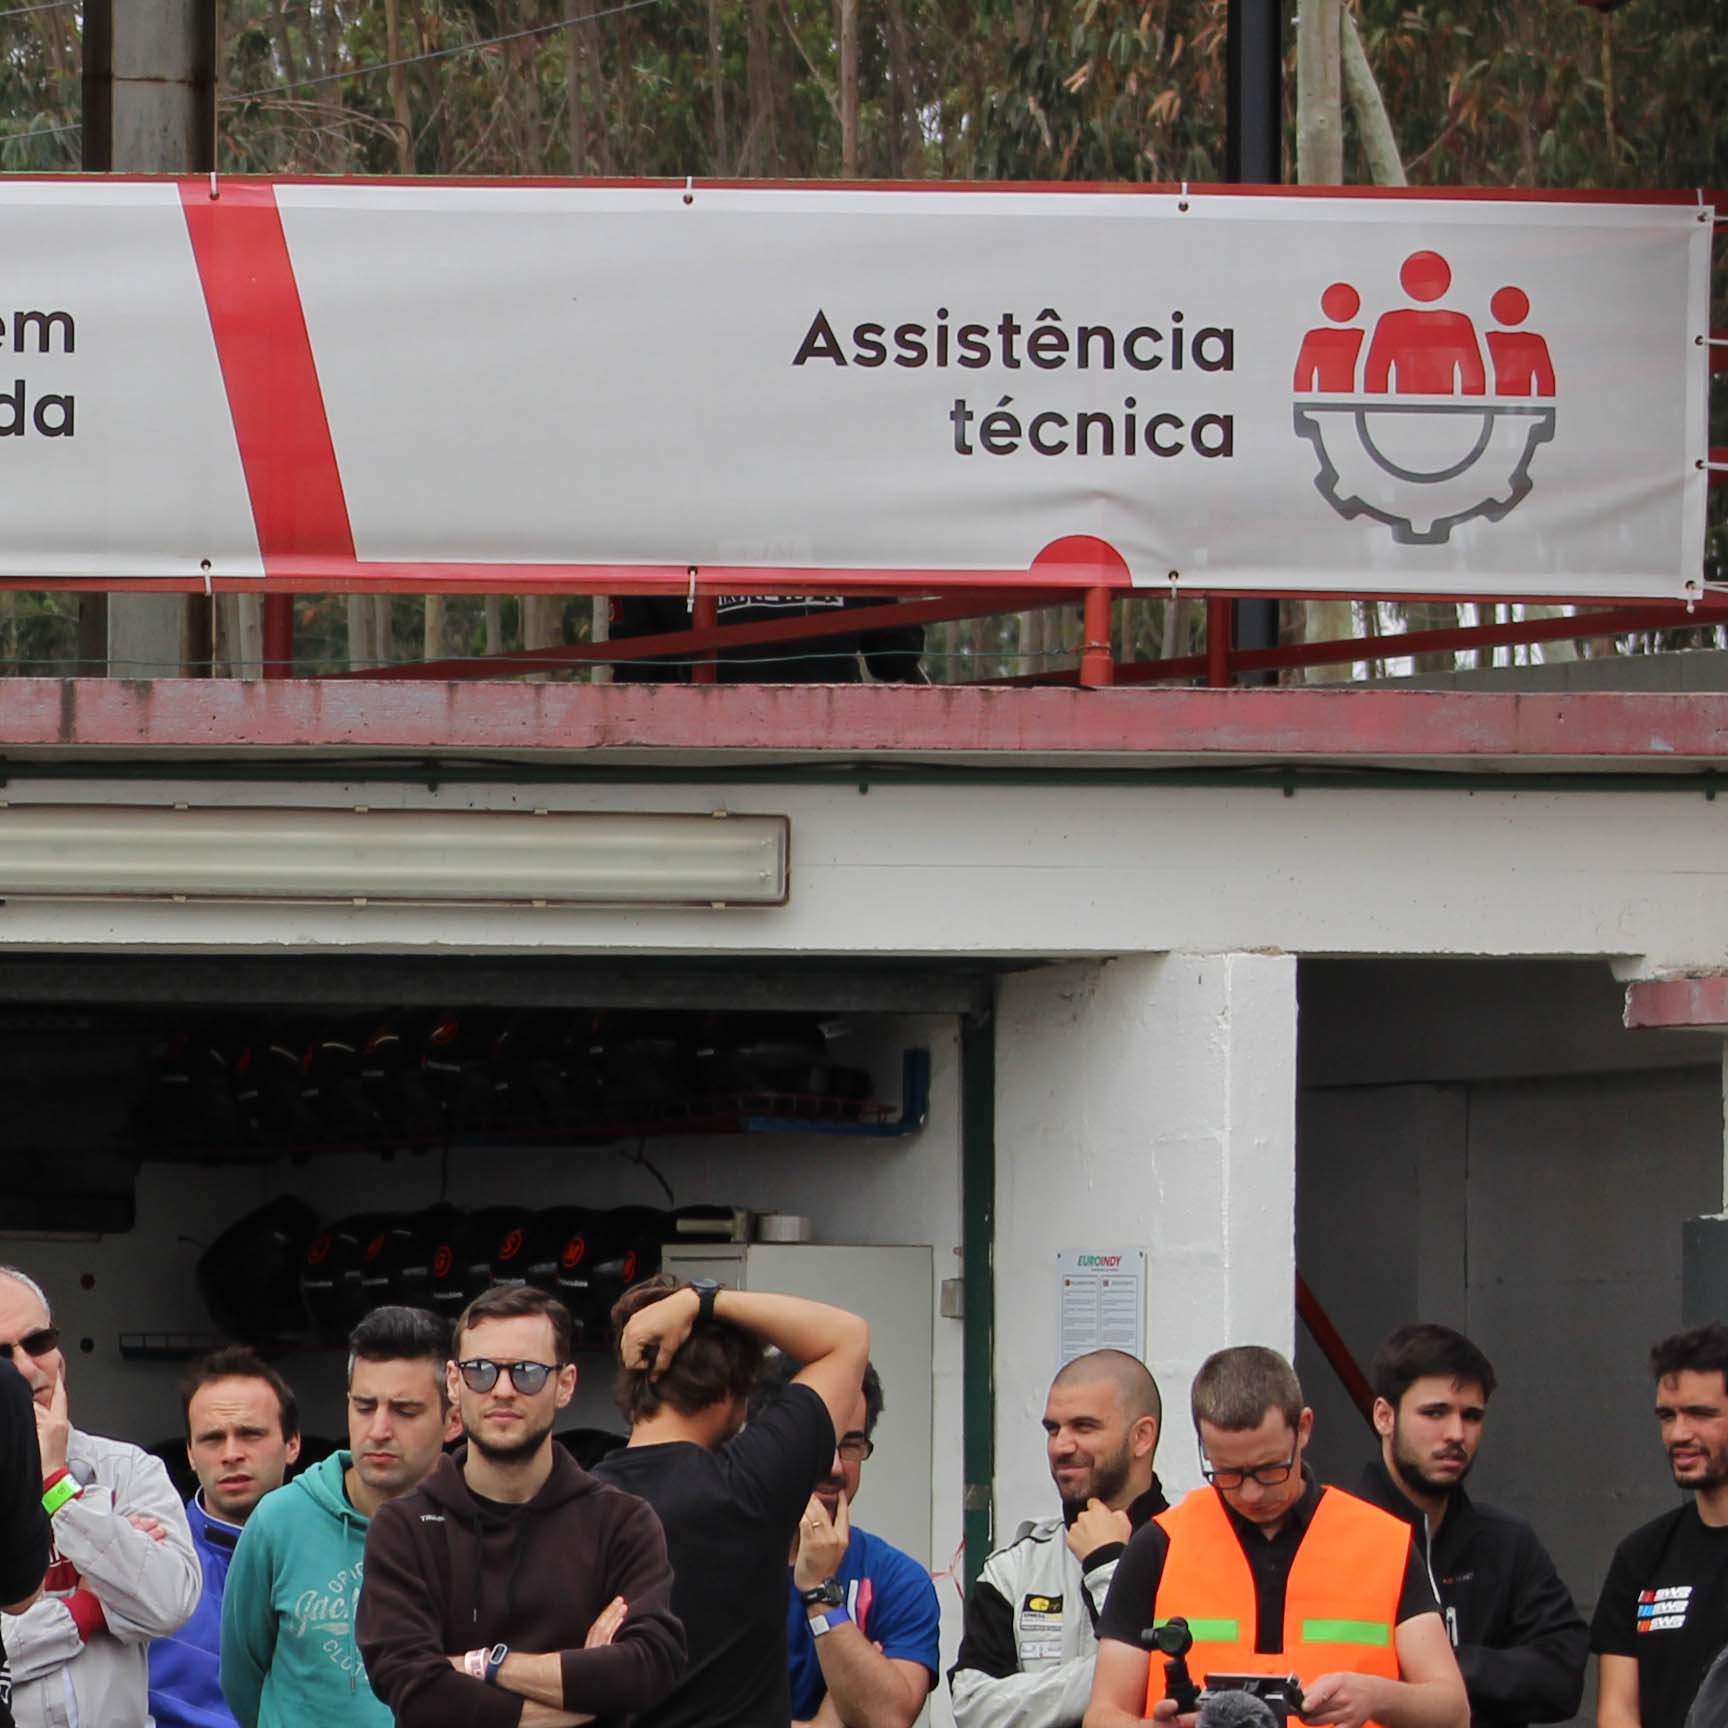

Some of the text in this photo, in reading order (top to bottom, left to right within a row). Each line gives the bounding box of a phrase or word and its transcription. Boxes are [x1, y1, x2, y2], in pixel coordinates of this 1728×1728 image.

[792, 307, 1234, 372] Assistência
[950, 395, 1234, 457] técnica
[1077, 1256, 1122, 1266] EUROINDY
